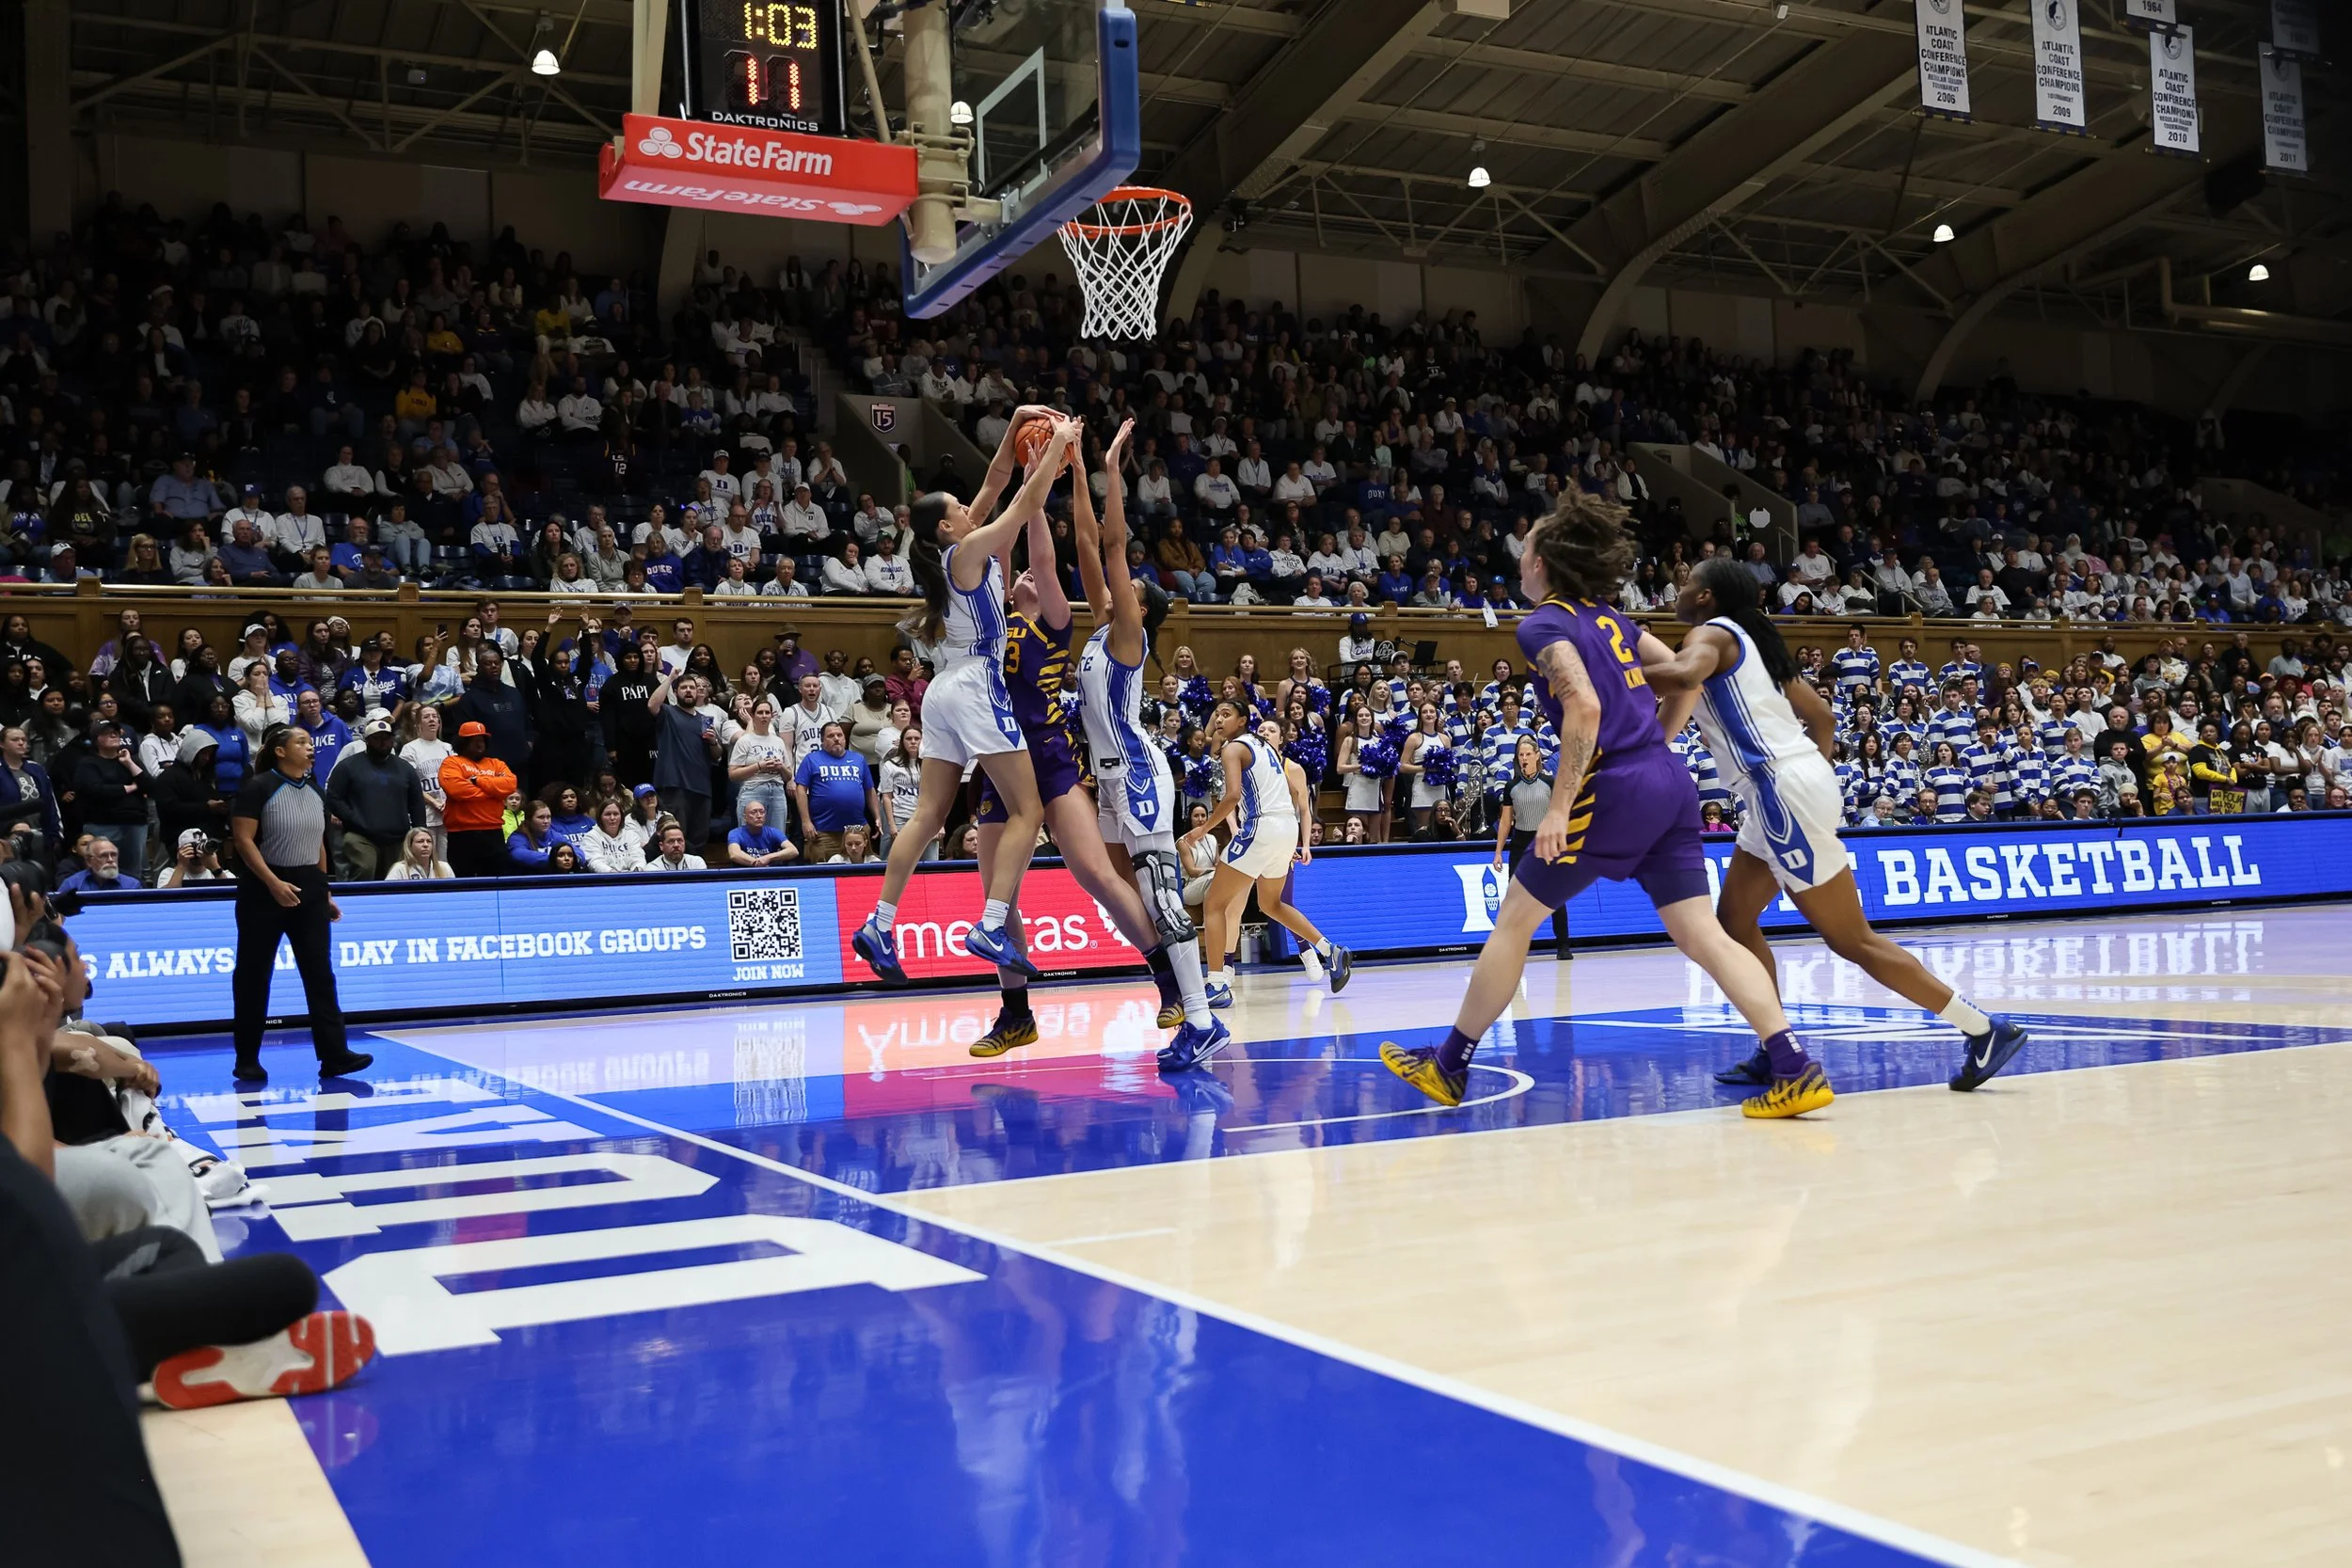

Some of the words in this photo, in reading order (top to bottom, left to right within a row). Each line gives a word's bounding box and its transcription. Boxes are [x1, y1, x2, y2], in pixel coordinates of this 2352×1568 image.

[2142, 1, 2162, 13] 1964
[743, 2, 817, 49] 1:03
[1926, 24, 1958, 40] ATLANTIC
[1931, 38, 1954, 51] COAST
[2042, 40, 2074, 55] ATLANTIC
[1921, 48, 1966, 66] CONFERENCE
[2049, 53, 2070, 66] COAST
[1924, 61, 1965, 78] CHAMPIONS
[2037, 64, 2081, 81] CONFERENCE
[2158, 68, 2189, 84] ATLANTIC
[746, 57, 801, 110] 11
[2039, 77, 2080, 93] CHAMPIONS
[2165, 81, 2185, 94] COAST
[1937, 91, 1956, 103] 2006
[2153, 91, 2196, 109] CONFERENCE
[2053, 104, 2071, 118] 2009
[2155, 103, 2195, 120] CHAMPIONS
[712, 111, 818, 132] DAKTRONICS
[2168, 131, 2187, 144] 2010
[876, 410, 893, 427] 15
[614, 462, 628, 475] 12
[646, 564, 673, 575] DUKE
[1596, 615, 1635, 664] 2
[1355, 645, 1373, 656] Duke
[1266, 749, 1282, 775] 4
[818, 765, 860, 779] DUKE
[1136, 800, 1155, 817] D
[1877, 834, 2262, 906] BASKETBALL
[105, 948, 235, 979] ALWAYS
[340, 940, 394, 967] DAY
[406, 937, 438, 964] IN
[446, 930, 593, 963] FACEBOOK
[599, 925, 707, 955] GROUPS
[733, 966, 768, 981] JOIN
[771, 964, 804, 979] NOW
[708, 990, 747, 999] DAKTRONICS
